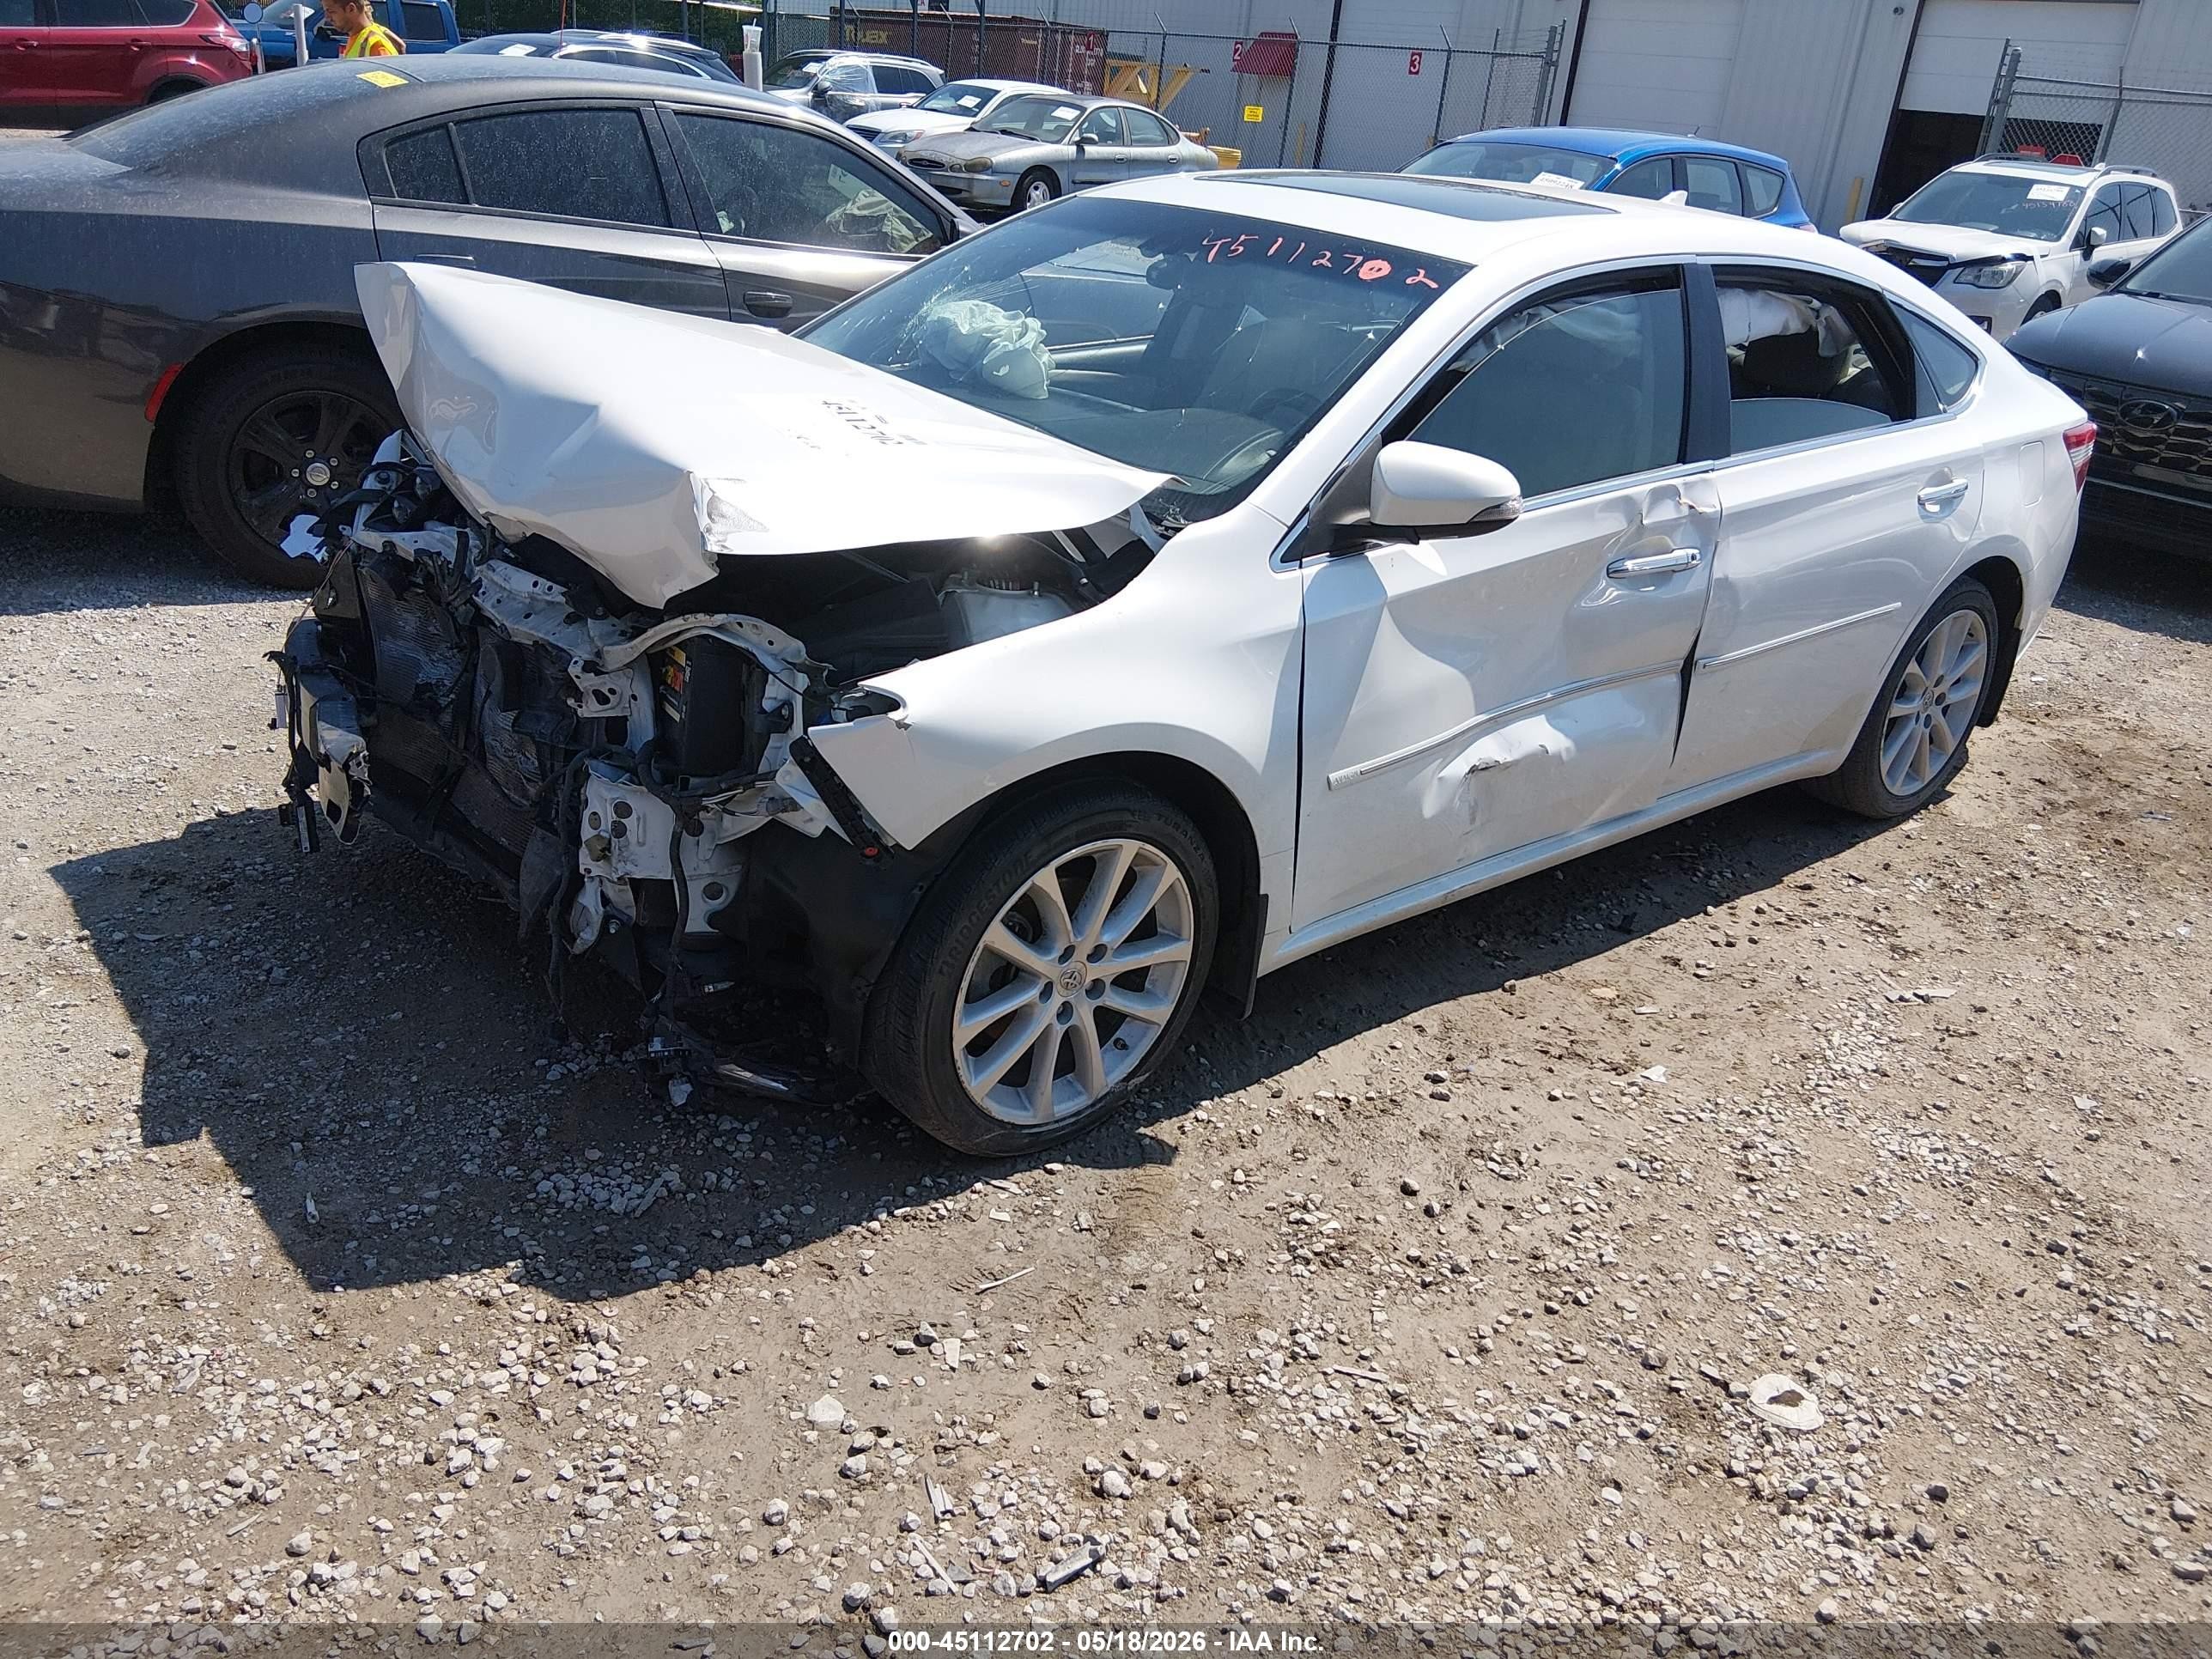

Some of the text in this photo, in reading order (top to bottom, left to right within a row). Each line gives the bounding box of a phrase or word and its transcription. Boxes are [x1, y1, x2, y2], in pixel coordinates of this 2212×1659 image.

[1087, 33, 1095, 49] 1
[1233, 44, 1243, 60] 2
[1409, 54, 1419, 73] 3
